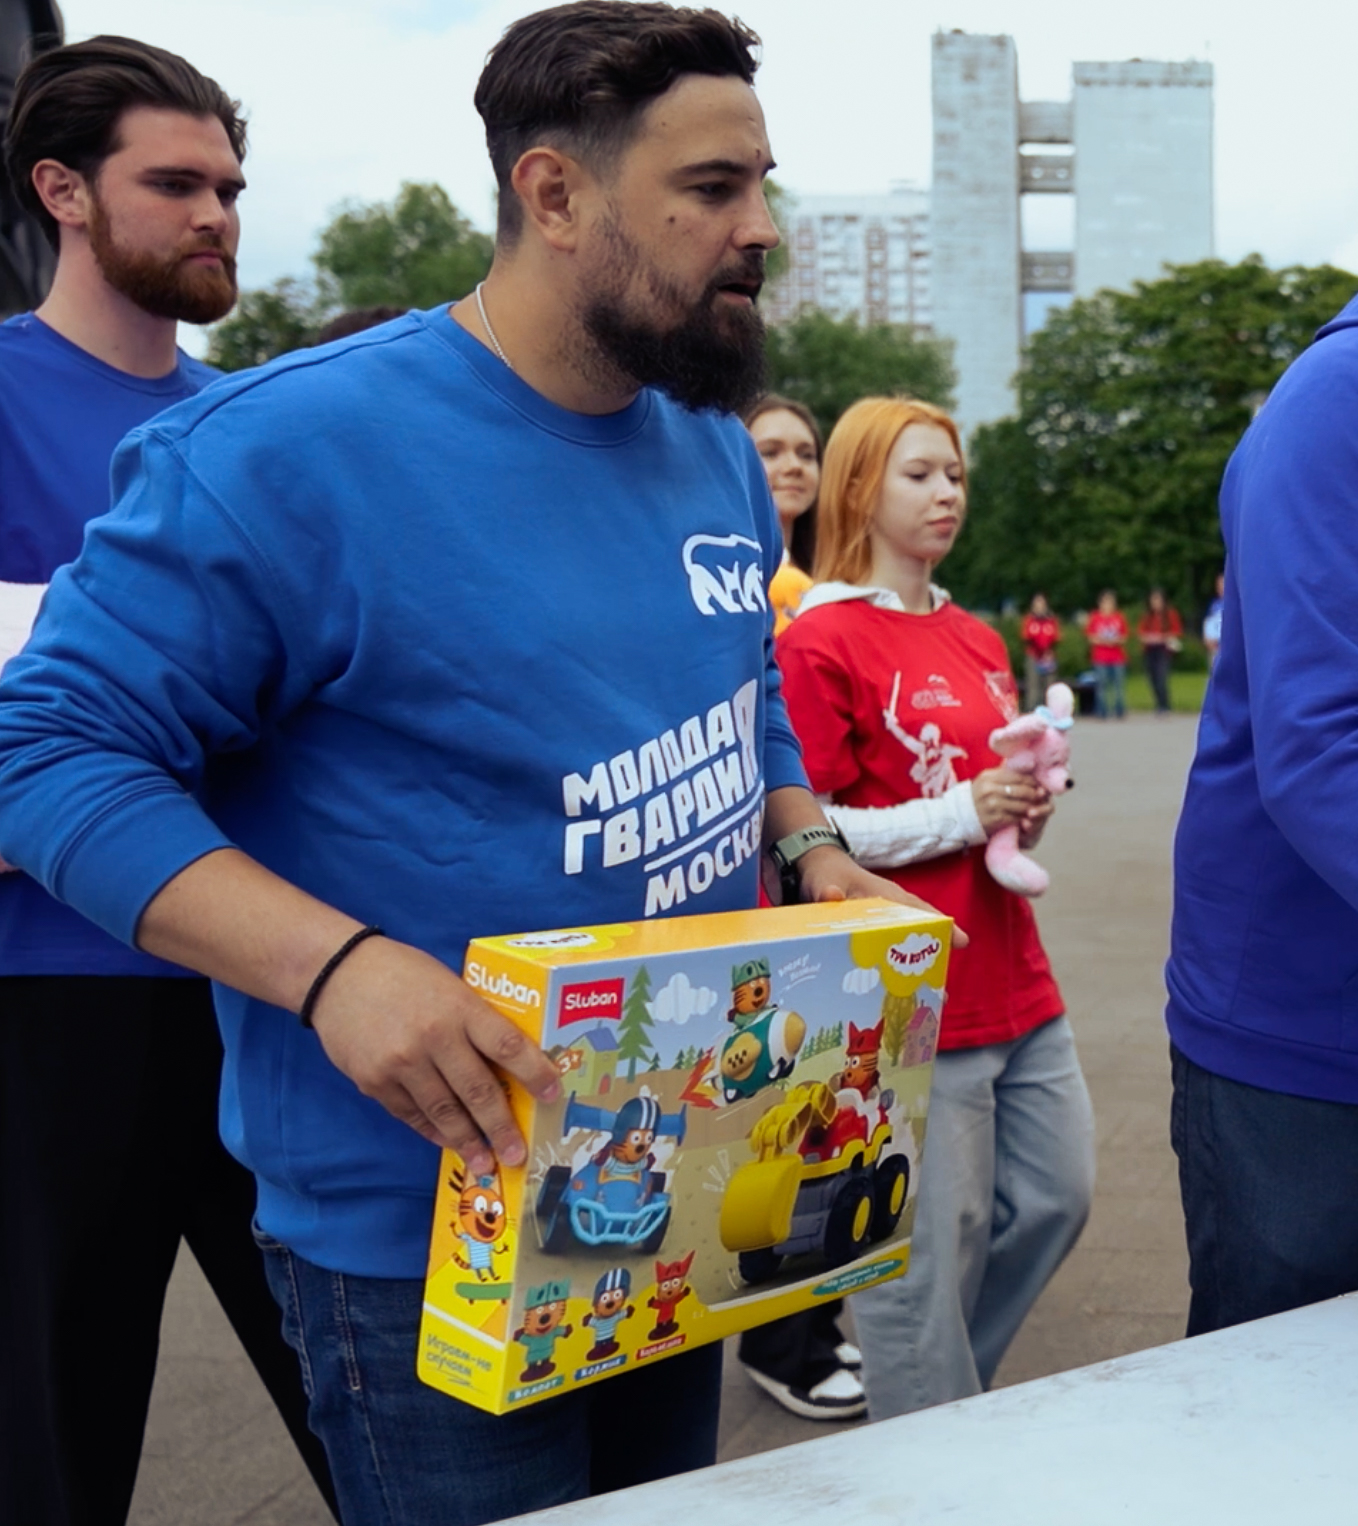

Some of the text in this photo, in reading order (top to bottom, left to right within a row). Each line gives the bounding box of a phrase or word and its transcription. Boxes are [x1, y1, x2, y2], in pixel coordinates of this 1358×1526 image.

[644, 806, 764, 917] МОСКВ
[466, 961, 541, 1008] Sluban
[564, 992, 618, 1010] Sluban
